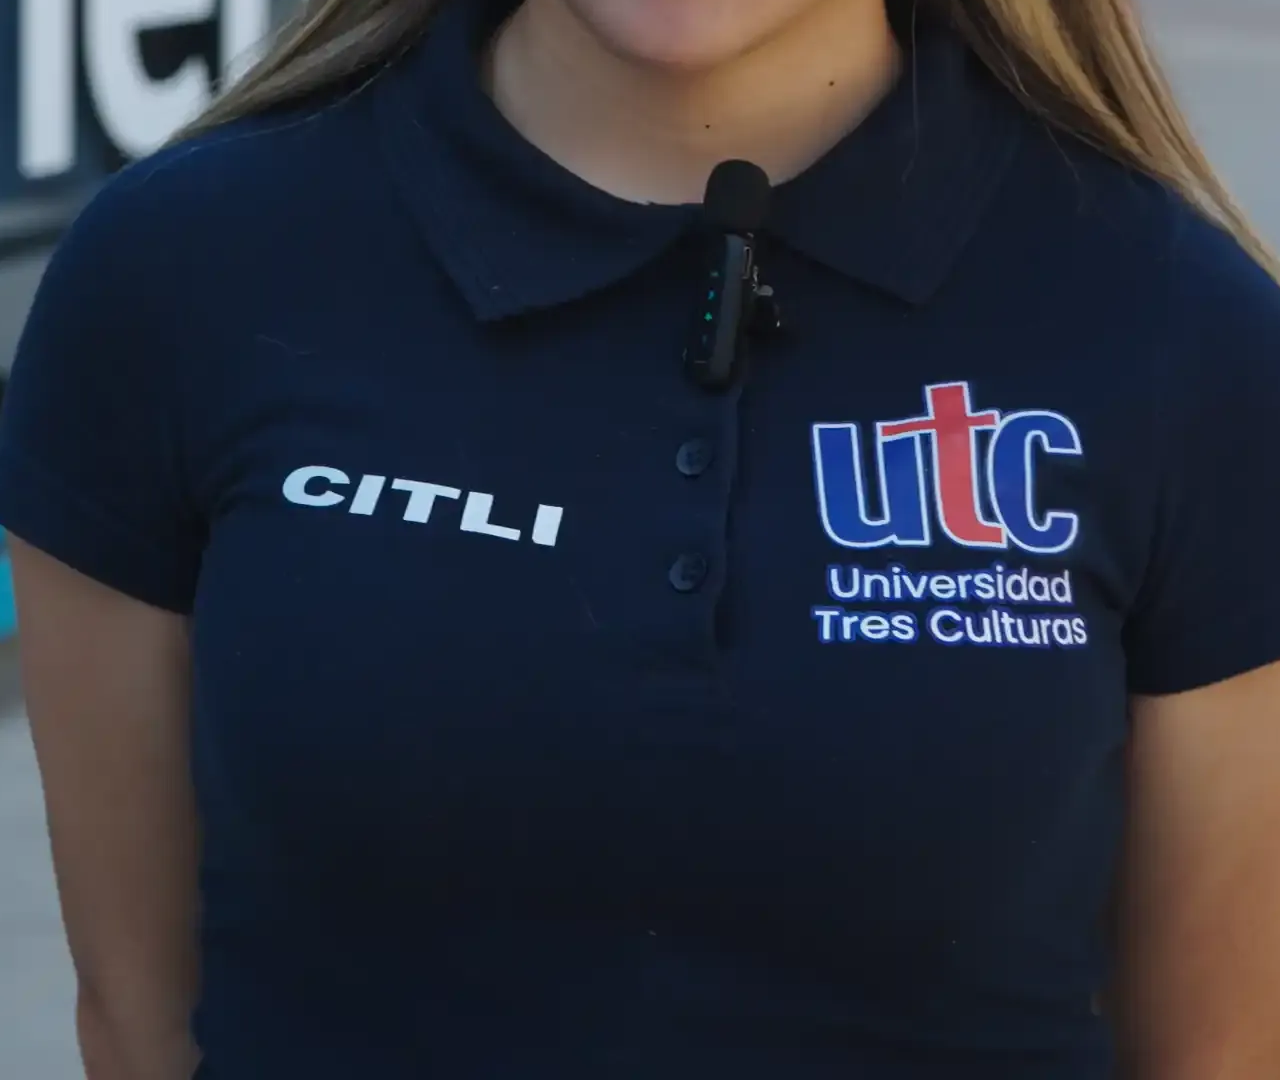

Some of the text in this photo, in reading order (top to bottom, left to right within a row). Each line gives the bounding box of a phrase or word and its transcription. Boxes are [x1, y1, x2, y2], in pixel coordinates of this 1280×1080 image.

[813, 381, 1082, 553] utc
[282, 465, 564, 546] CITLI
[830, 566, 1072, 602] Universidad
[815, 609, 1087, 644] Tres Culturas
